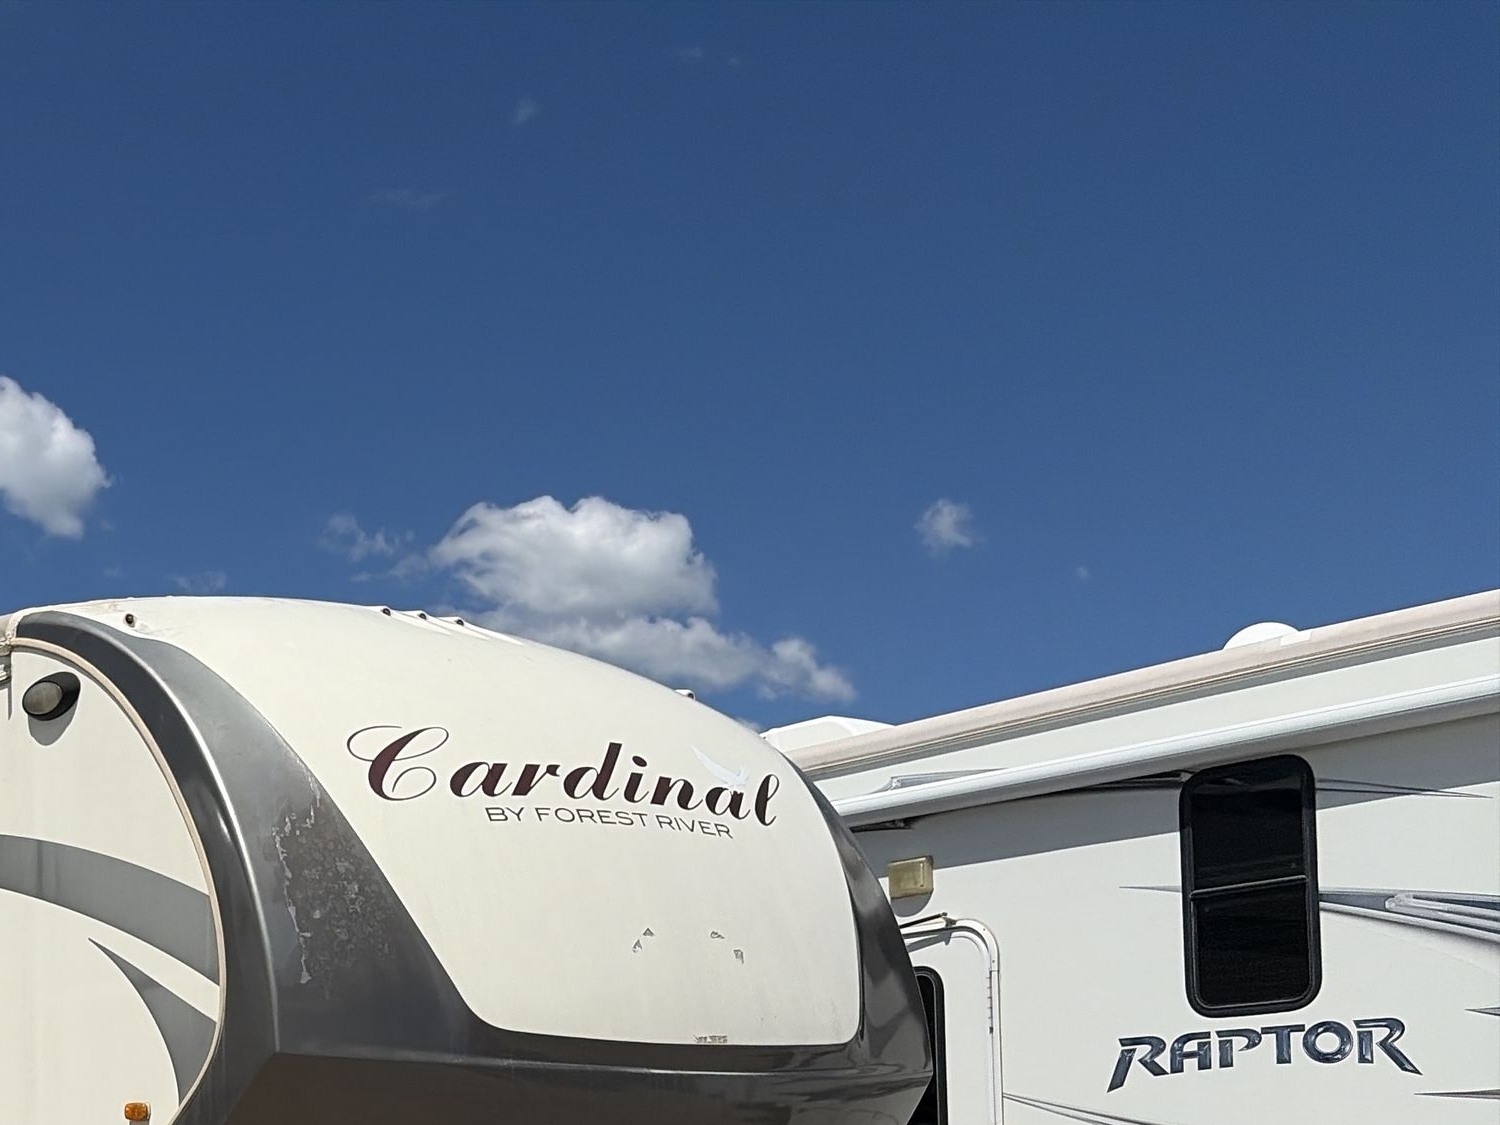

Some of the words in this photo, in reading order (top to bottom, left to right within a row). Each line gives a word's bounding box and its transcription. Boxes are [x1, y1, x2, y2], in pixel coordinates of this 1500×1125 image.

[346, 726, 780, 826] Cardinal
[487, 807, 524, 823] BY
[537, 806, 649, 828] FOREST
[658, 815, 733, 839] RIVER
[1106, 1017, 1423, 1093] RAPTOR
